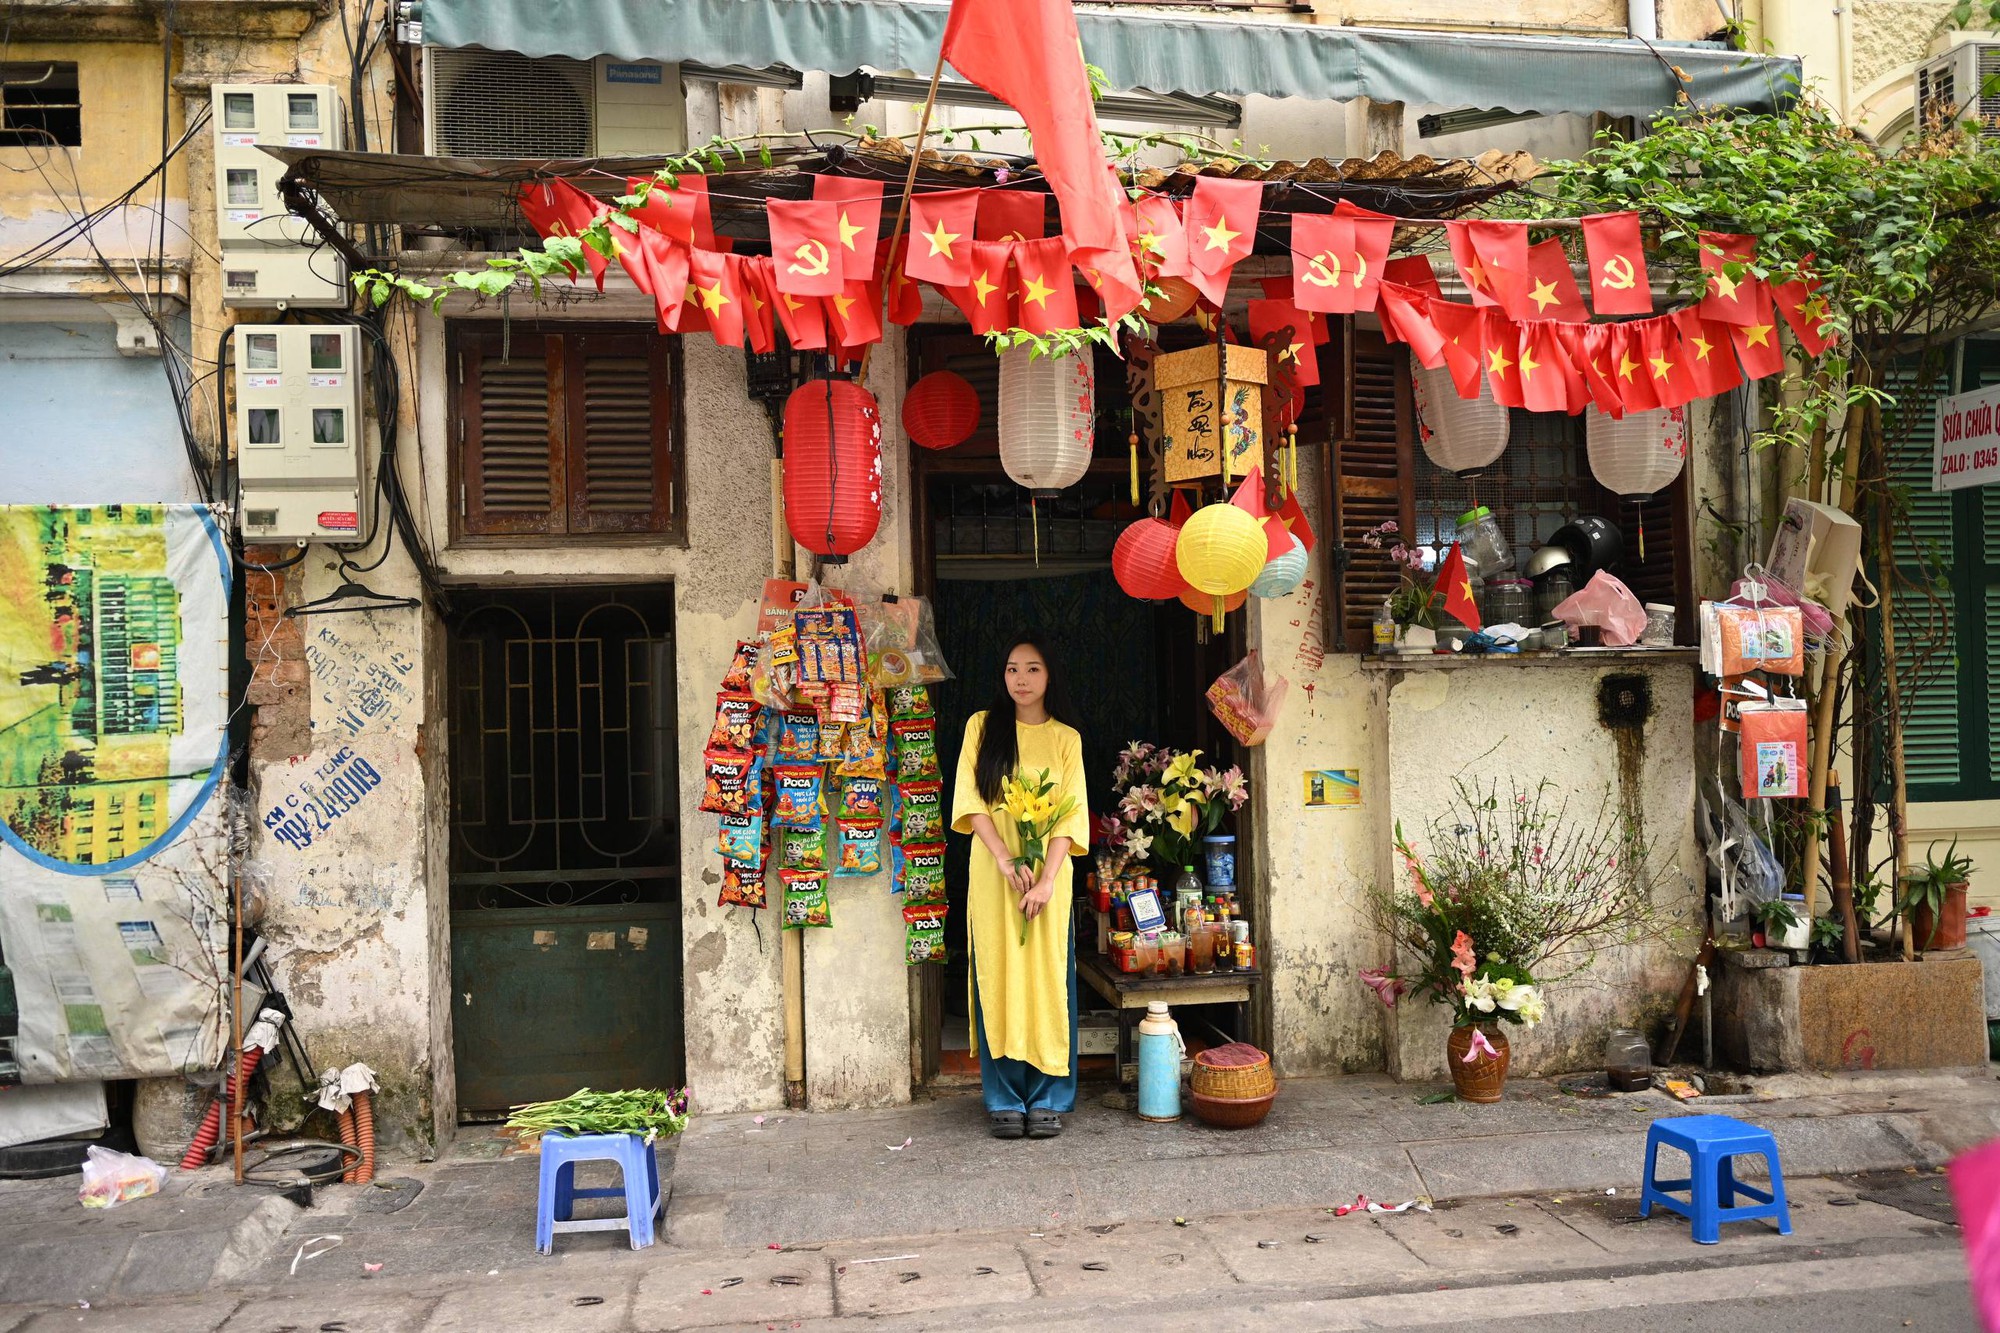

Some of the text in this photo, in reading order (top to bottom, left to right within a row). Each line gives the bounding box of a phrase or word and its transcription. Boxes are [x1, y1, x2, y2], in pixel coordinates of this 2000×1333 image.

[609, 68, 659, 78] Panasonic
[1942, 402, 1962, 443] SỬA
[1965, 400, 1992, 440] CHỮA
[1974, 448, 1998, 470] 0345
[723, 702, 749, 710] POCA
[787, 715, 814, 724] POCA
[904, 732, 929, 741] POCA
[712, 764, 738, 775] POCA
[783, 778, 811, 787] POCA
[853, 784, 877, 792] CUA
[912, 794, 936, 804] POCA
[724, 816, 749, 826] POCA
[848, 830, 874, 839] POCA
[915, 857, 939, 866] POCA
[792, 882, 818, 891] POCA
[915, 920, 942, 930] POCA
